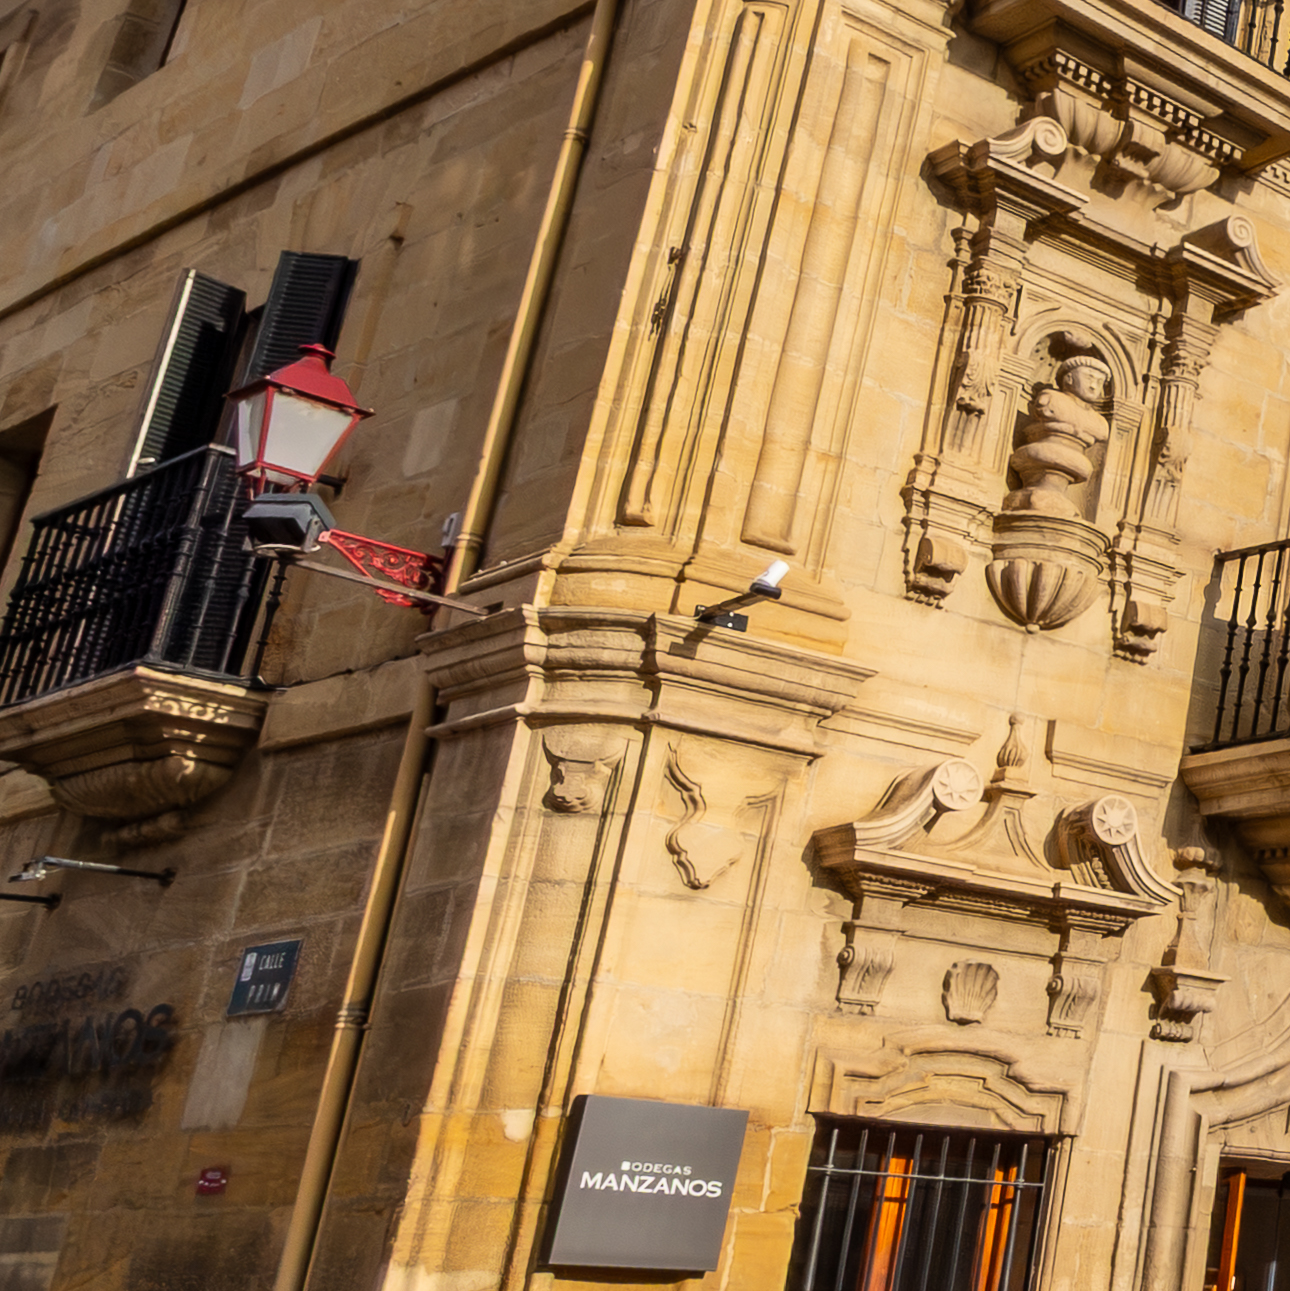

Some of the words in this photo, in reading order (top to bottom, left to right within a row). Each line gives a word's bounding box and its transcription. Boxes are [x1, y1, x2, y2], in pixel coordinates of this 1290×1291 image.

[259, 952, 286, 970] CALLE
[621, 1161, 692, 1175] BODEGAS
[580, 1171, 722, 1198] MANZANOS
